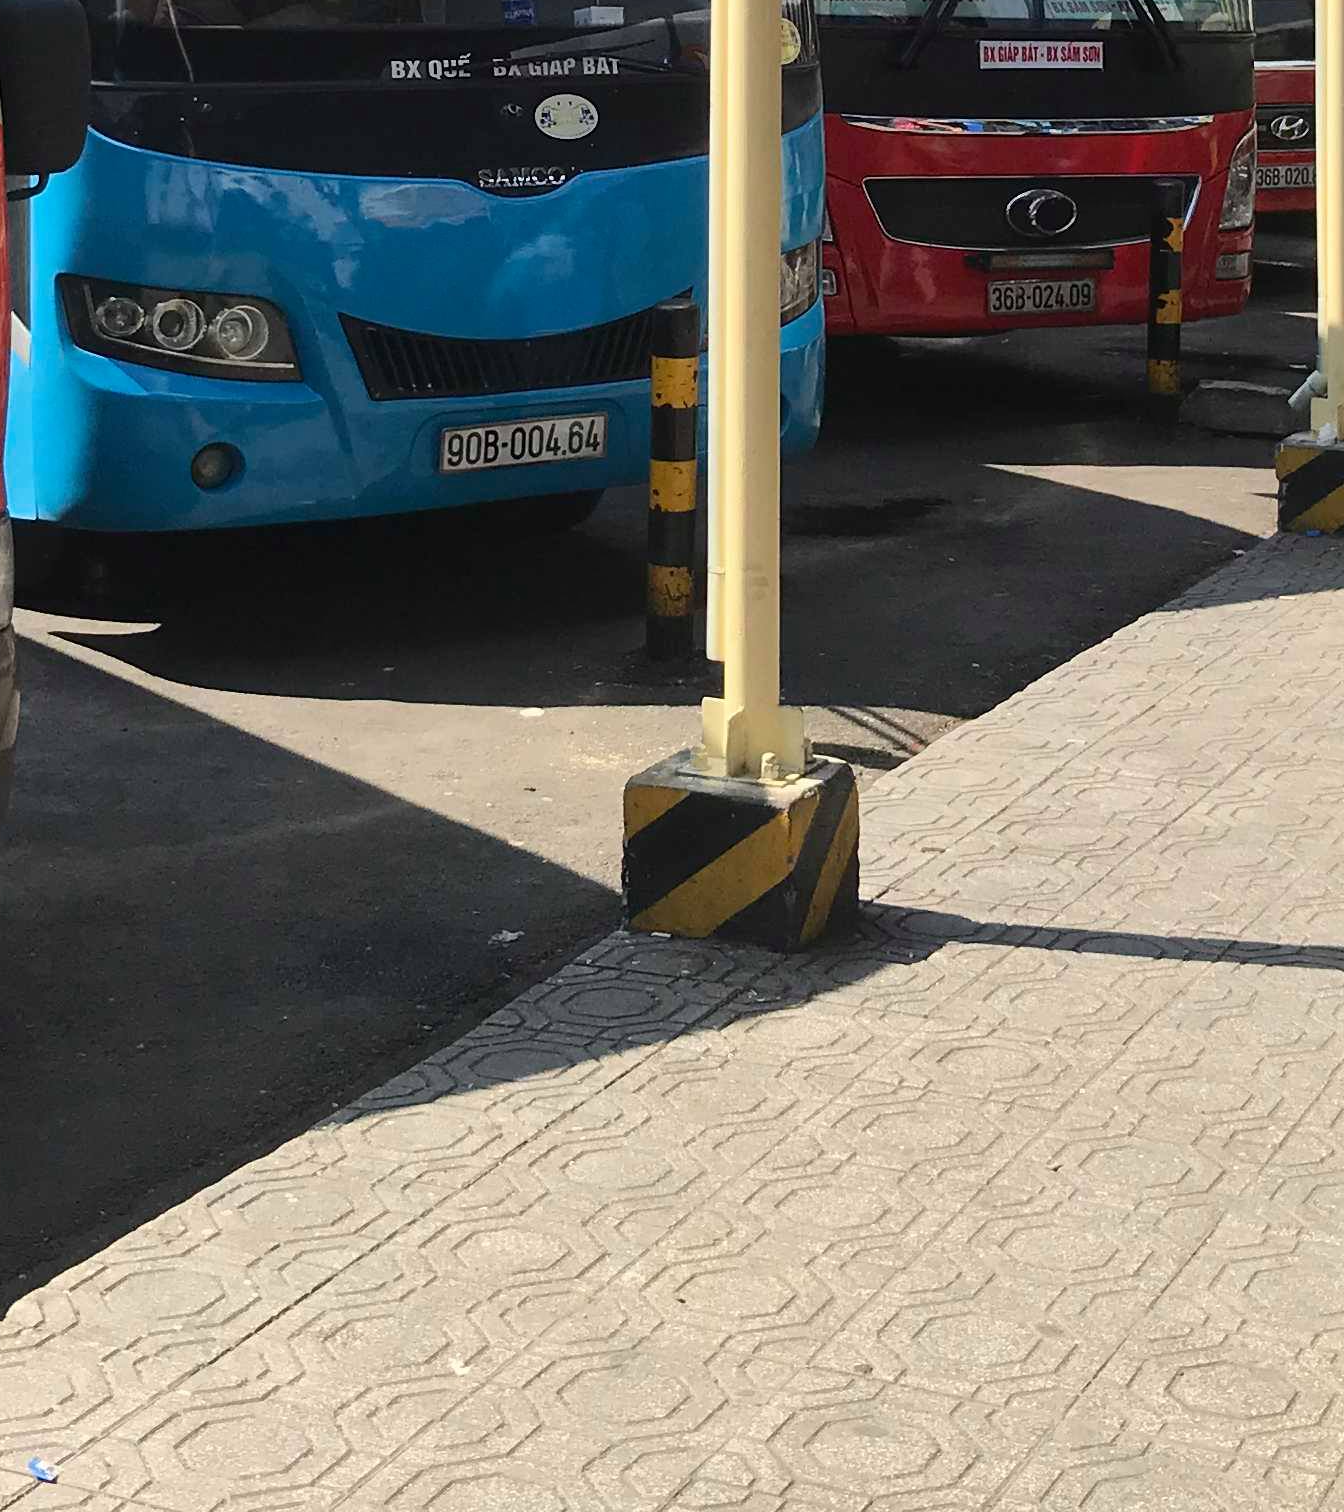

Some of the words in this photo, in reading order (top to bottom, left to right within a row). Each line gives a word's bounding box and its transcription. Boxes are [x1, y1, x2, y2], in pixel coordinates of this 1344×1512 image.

[983, 45, 995, 63] BX
[998, 42, 1019, 63] GIÁP
[1022, 43, 1038, 63] BÁT
[1046, 45, 1059, 63] BX
[390, 60, 422, 79] BX
[1256, 167, 1316, 186] 36B-020.
[992, 283, 1091, 310] 36B-024.09
[447, 419, 601, 467] 90B-004.64
